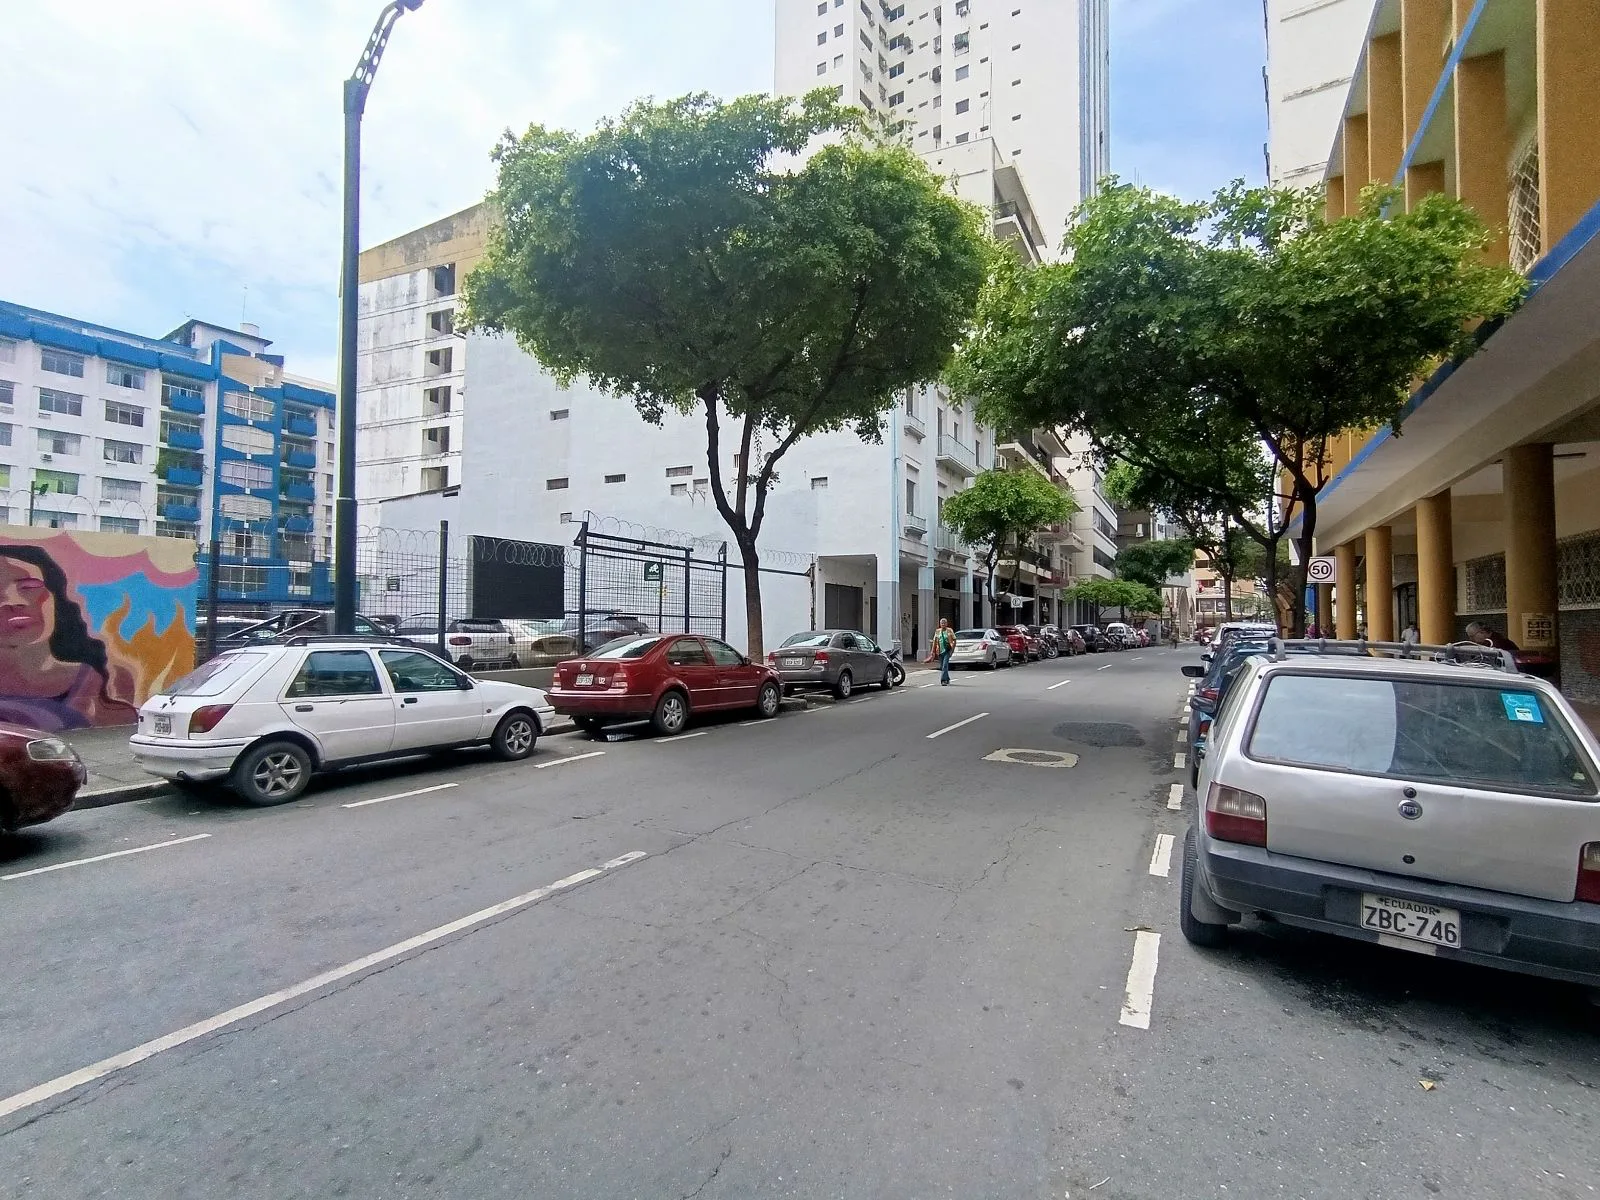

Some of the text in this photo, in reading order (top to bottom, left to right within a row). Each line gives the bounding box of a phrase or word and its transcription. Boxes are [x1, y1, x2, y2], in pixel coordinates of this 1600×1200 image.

[1312, 565, 1329, 575] 50
[1402, 805, 1418, 814] FIAT
[1384, 897, 1437, 916] ECUADOR
[1364, 905, 1458, 944] ZBC-746
